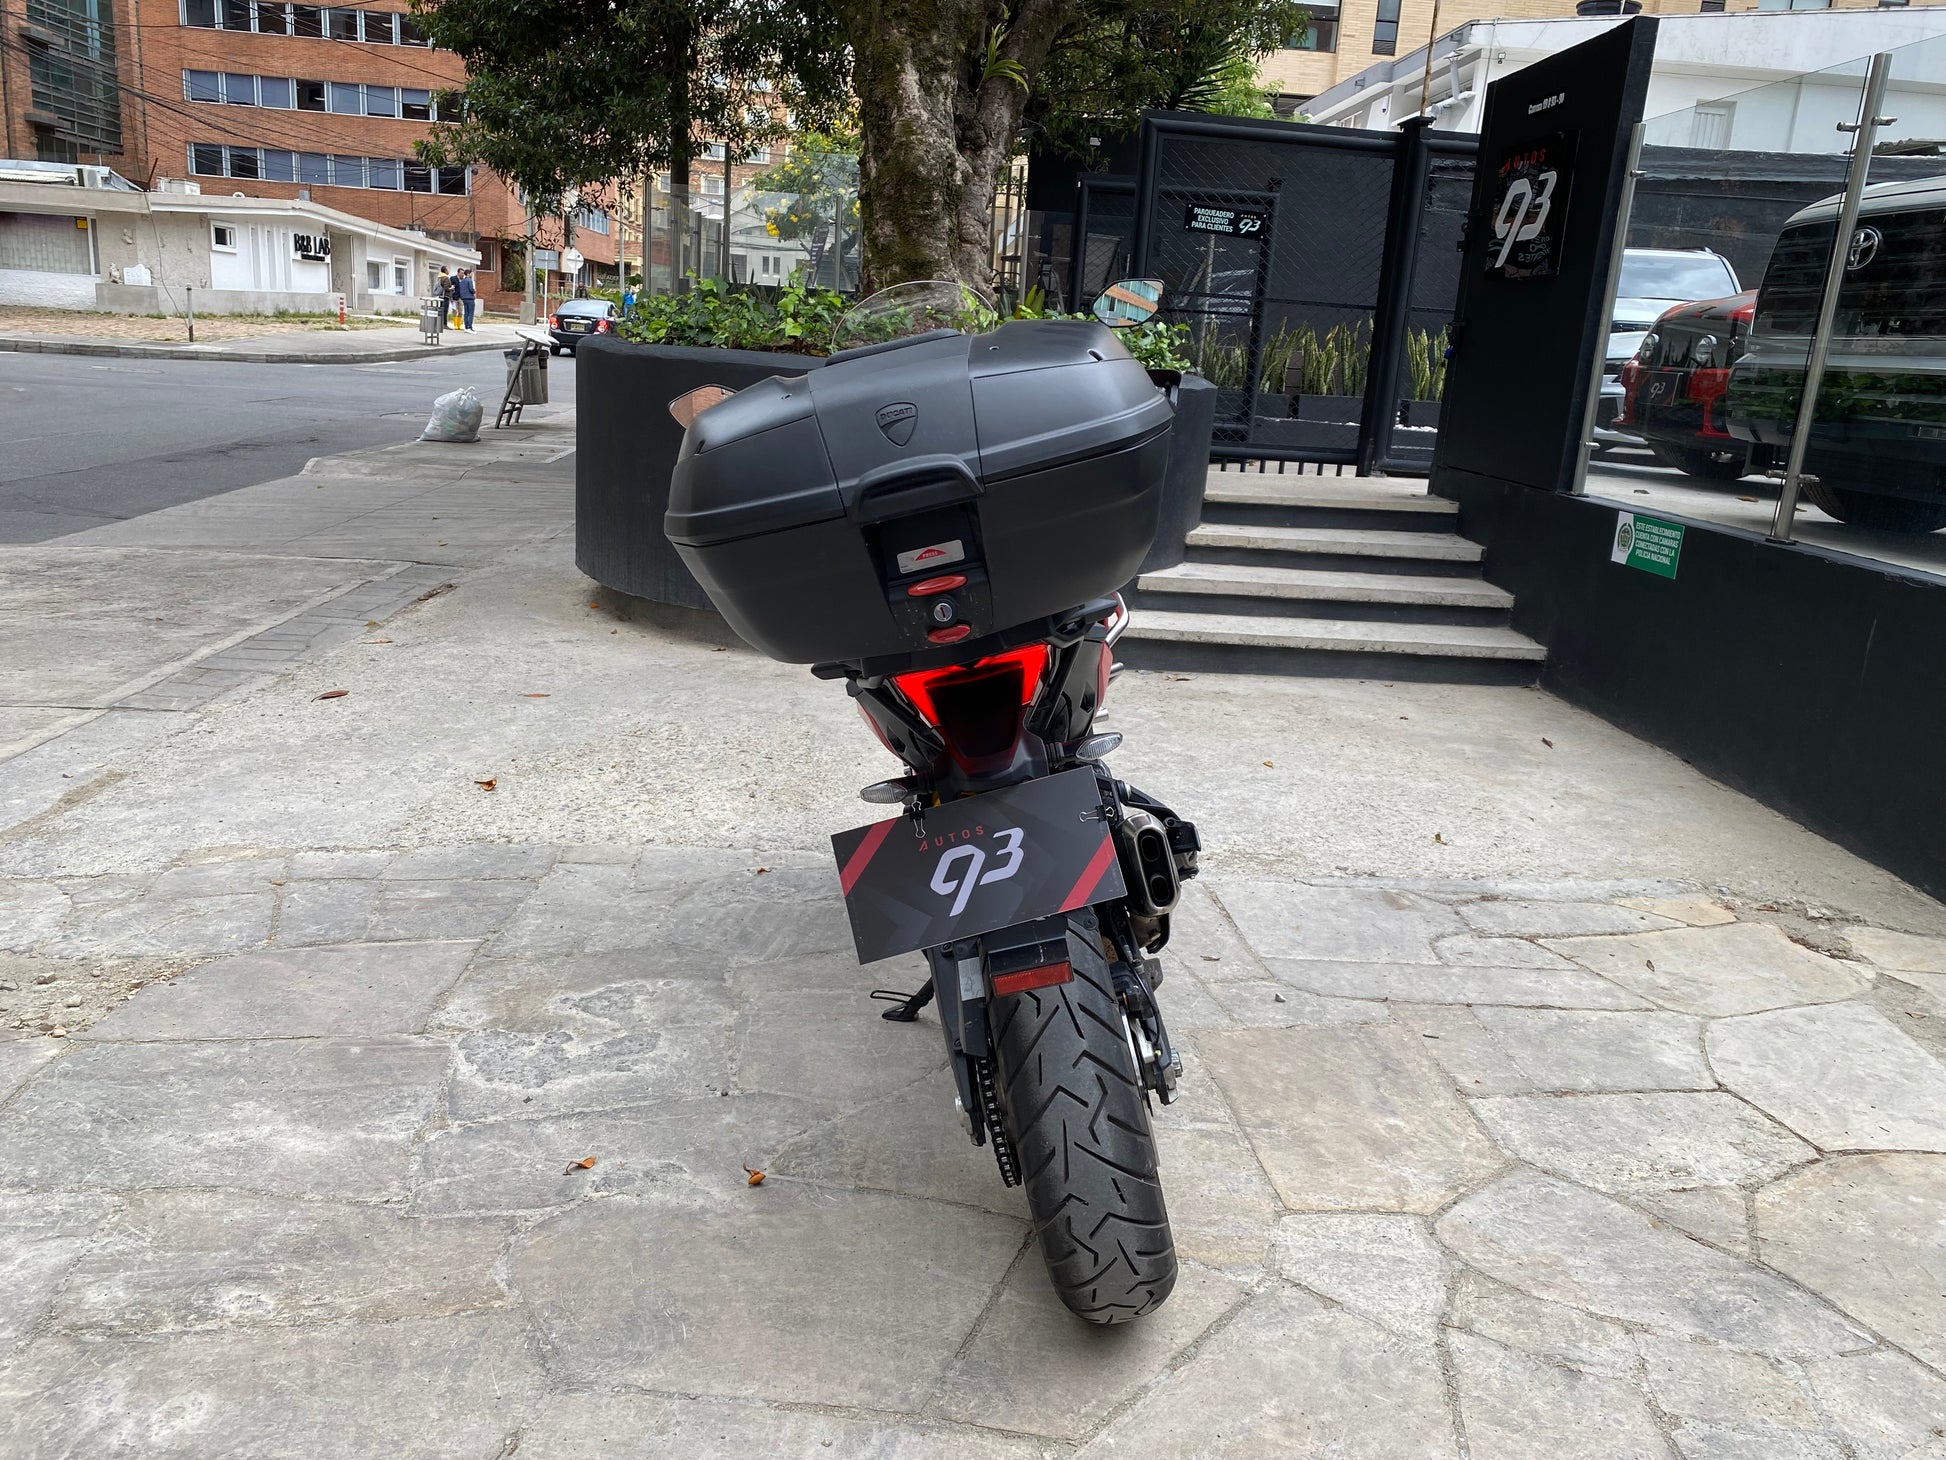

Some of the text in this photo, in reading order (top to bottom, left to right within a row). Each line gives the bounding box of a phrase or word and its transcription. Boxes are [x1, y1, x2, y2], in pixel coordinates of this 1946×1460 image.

[1499, 148, 1546, 174] AUTOS
[1193, 207, 1235, 219] PARQUEADERO
[1197, 214, 1229, 225] EXCLUSIVO
[1495, 170, 1558, 268] 93
[1191, 221, 1234, 233] PARA CLIENTES
[1239, 218, 1262, 234] 93
[313, 236, 331, 255] LAB
[1650, 382, 1666, 399] 93
[880, 406, 913, 420] DUCATI
[1649, 534, 1659, 543] CON
[922, 551, 938, 559] PRESS
[1659, 546, 1669, 555] CON
[1669, 548, 1675, 557] LA
[1650, 552, 1671, 566] NACIONAL
[919, 825, 985, 852] AUTOS
[930, 827, 1024, 917] 93
